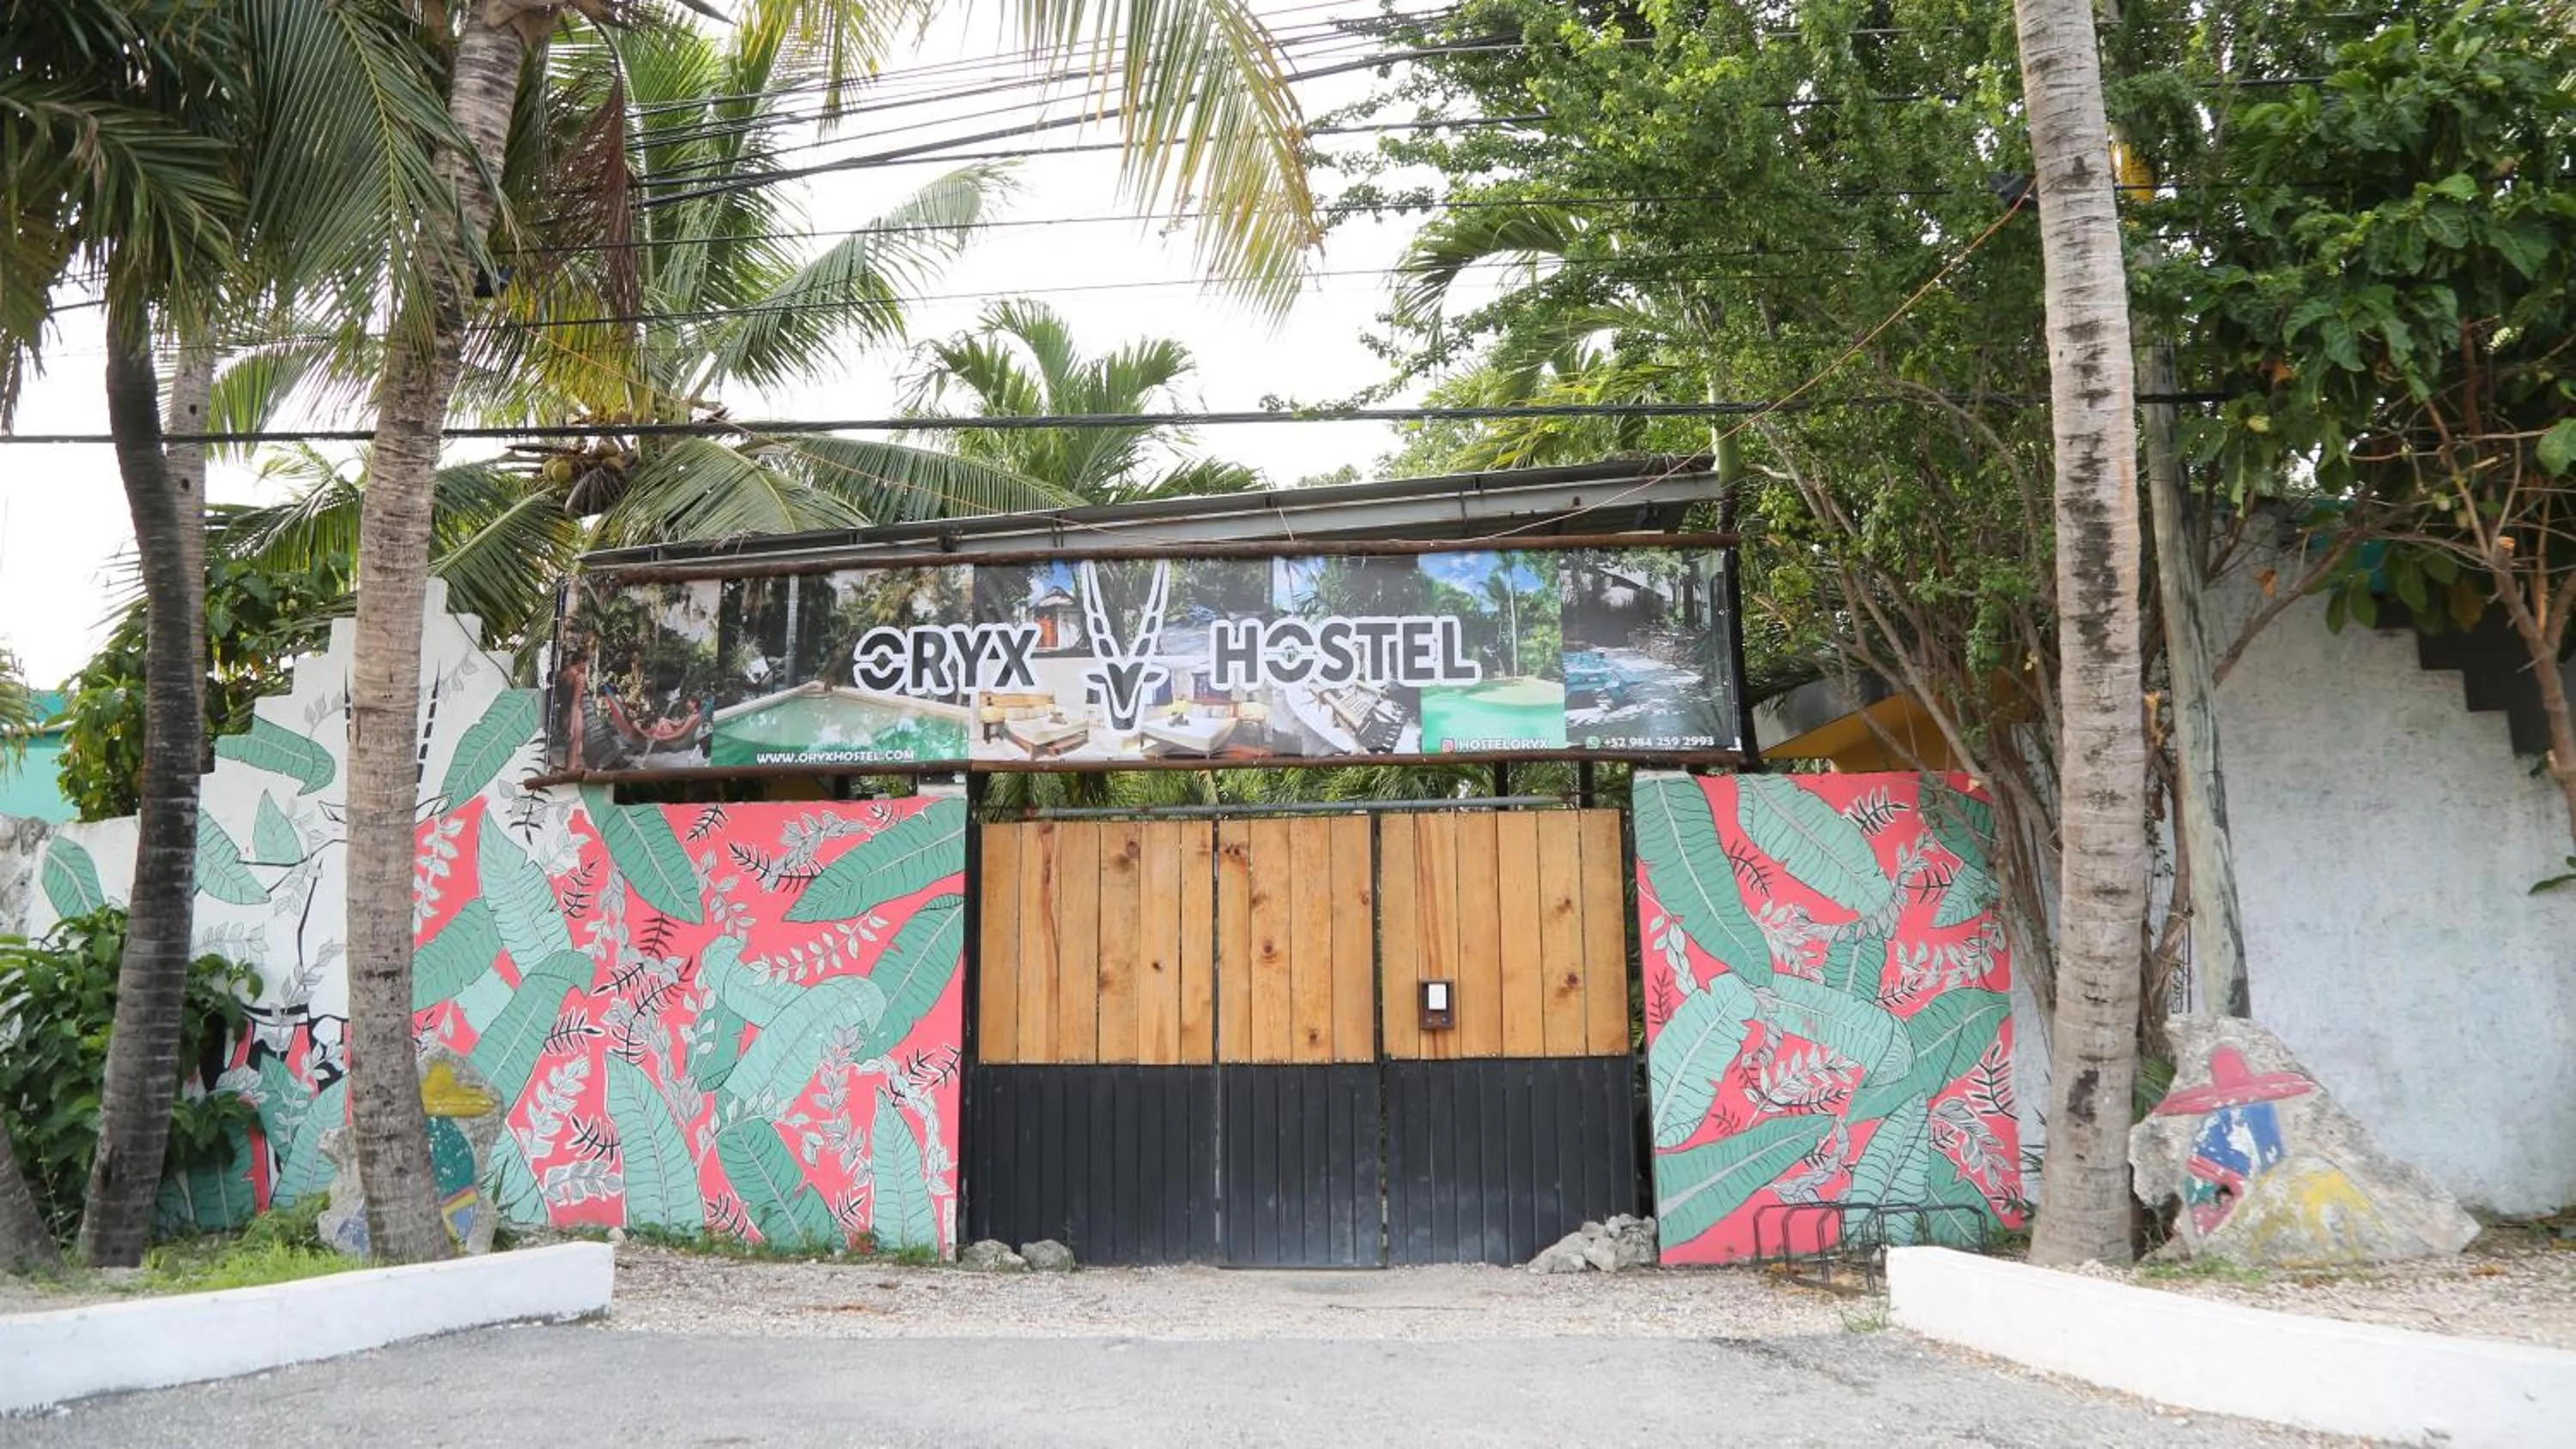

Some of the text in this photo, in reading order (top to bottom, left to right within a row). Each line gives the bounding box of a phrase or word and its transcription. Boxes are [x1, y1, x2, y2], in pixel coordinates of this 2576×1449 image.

[856, 620, 1477, 693] ORYX HOSTEL
[1458, 739, 1548, 751] HOSTELORYX
[1603, 736, 1715, 748] +52 984 259 2993
[756, 749, 914, 763] WWW.ORYXHOSTEL.COM
